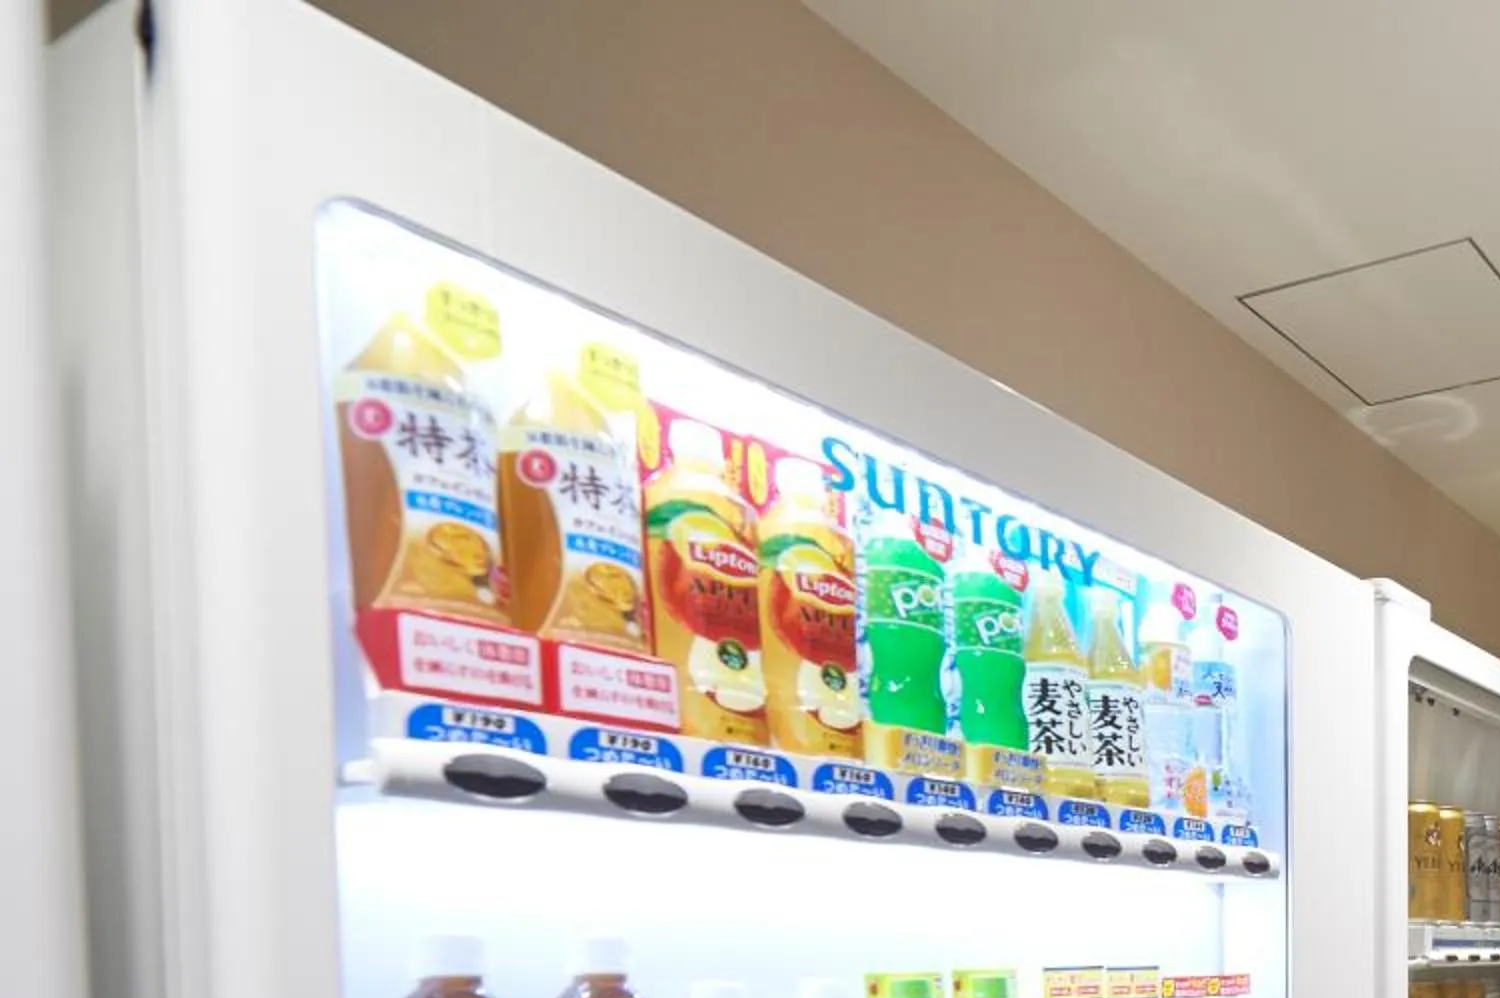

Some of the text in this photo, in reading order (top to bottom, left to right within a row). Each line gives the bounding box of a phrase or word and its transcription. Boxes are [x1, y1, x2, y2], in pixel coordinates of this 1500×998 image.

[821, 437, 1100, 588] SUNTORY
[1028, 678, 1065, 755] 麦茶
[1062, 678, 1088, 756] やさしい
[1089, 694, 1126, 769] 麦茶
[1121, 695, 1144, 768] やさしい
